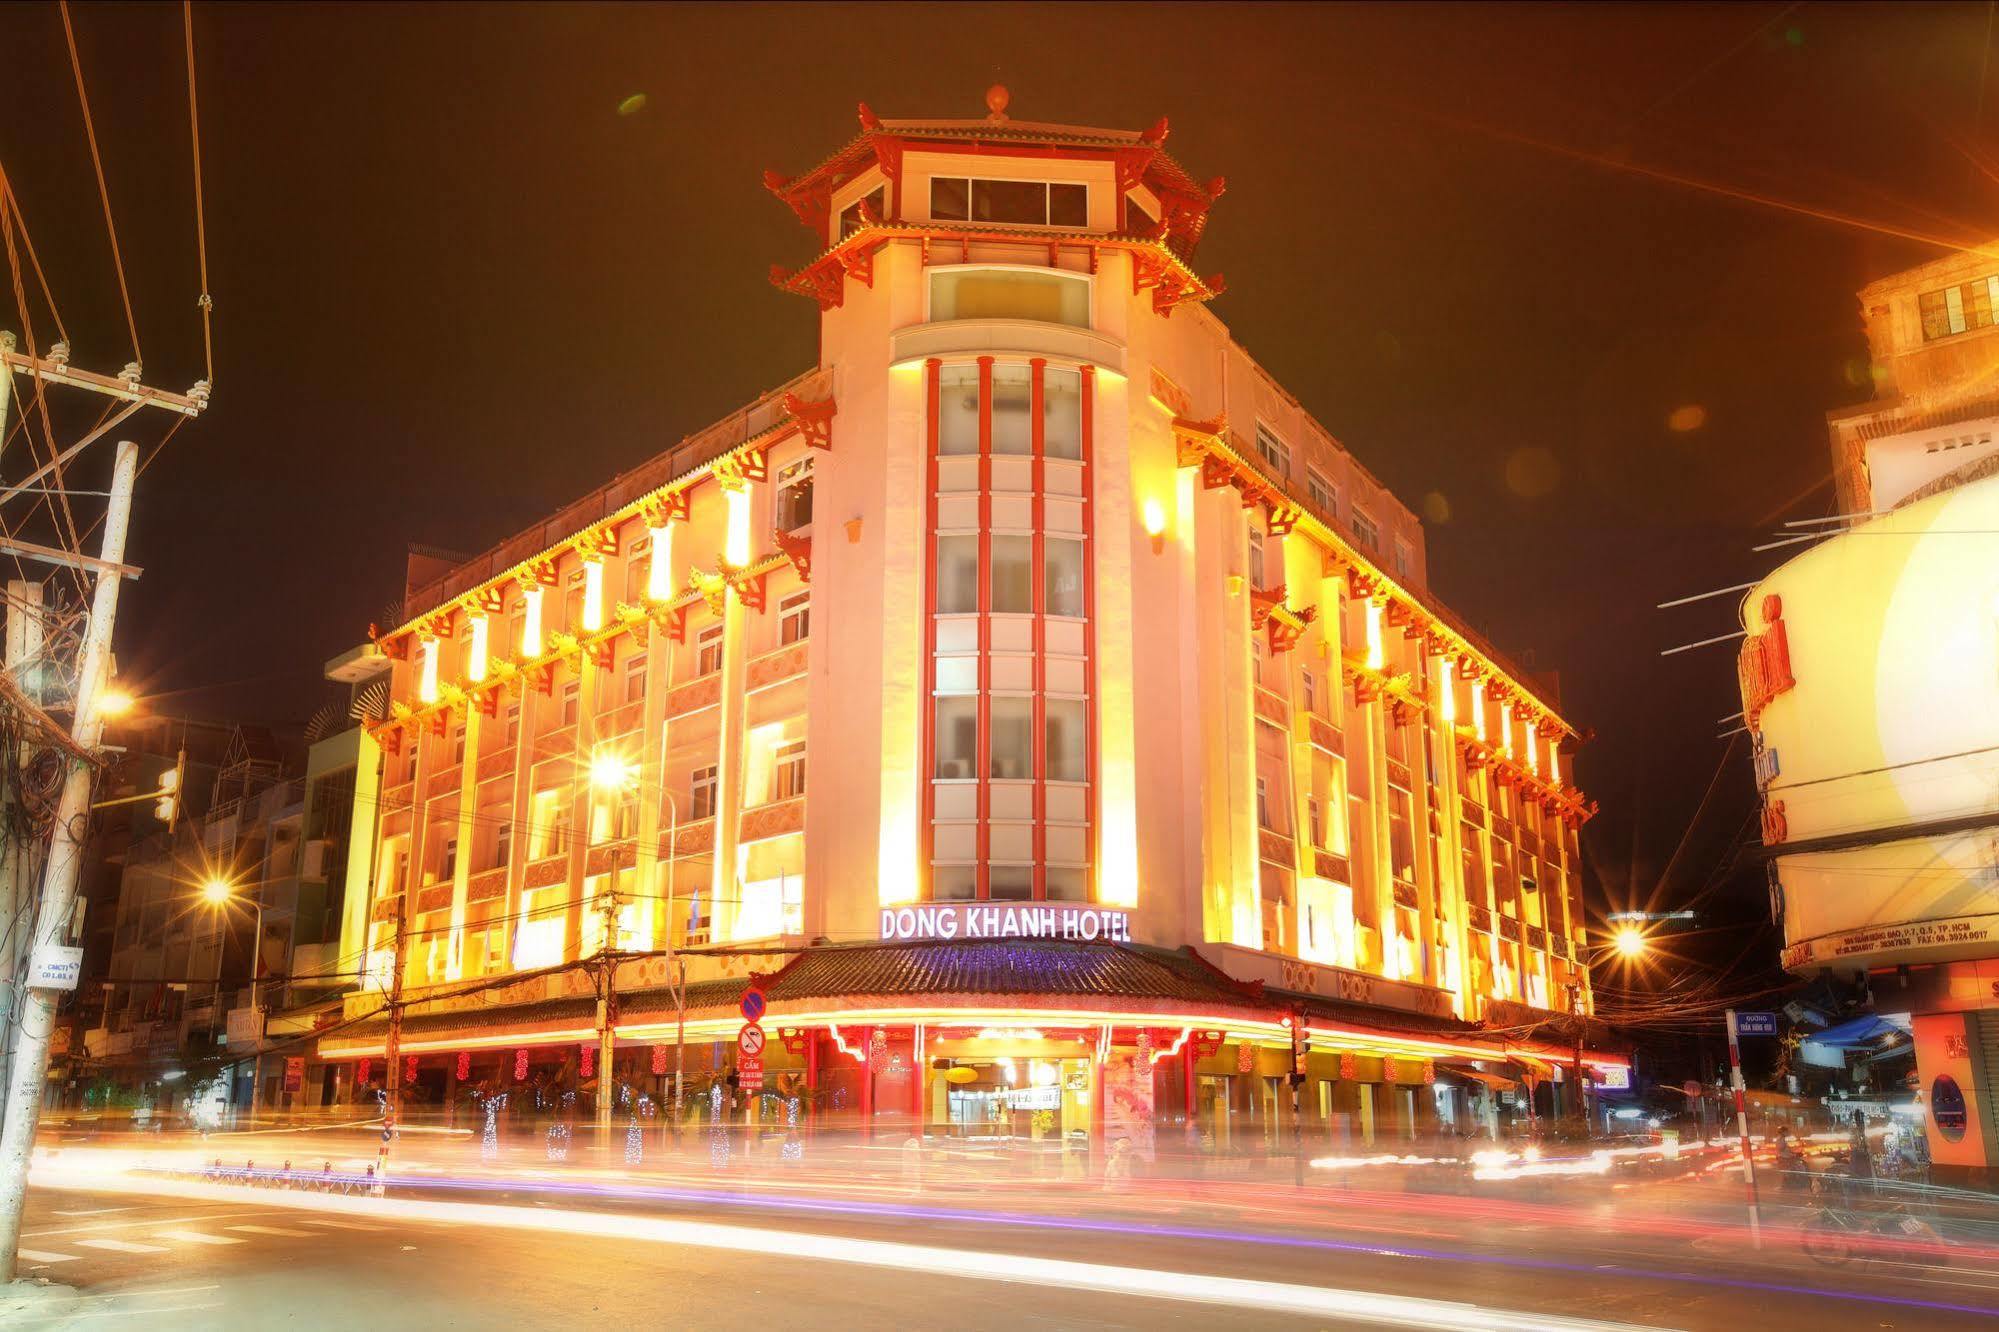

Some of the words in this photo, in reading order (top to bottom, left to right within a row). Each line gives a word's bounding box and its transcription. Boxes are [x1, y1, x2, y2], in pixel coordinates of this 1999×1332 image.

[881, 907, 958, 940] DONG
[966, 906, 1056, 939] KHANH
[1062, 909, 1131, 943] HOTEL
